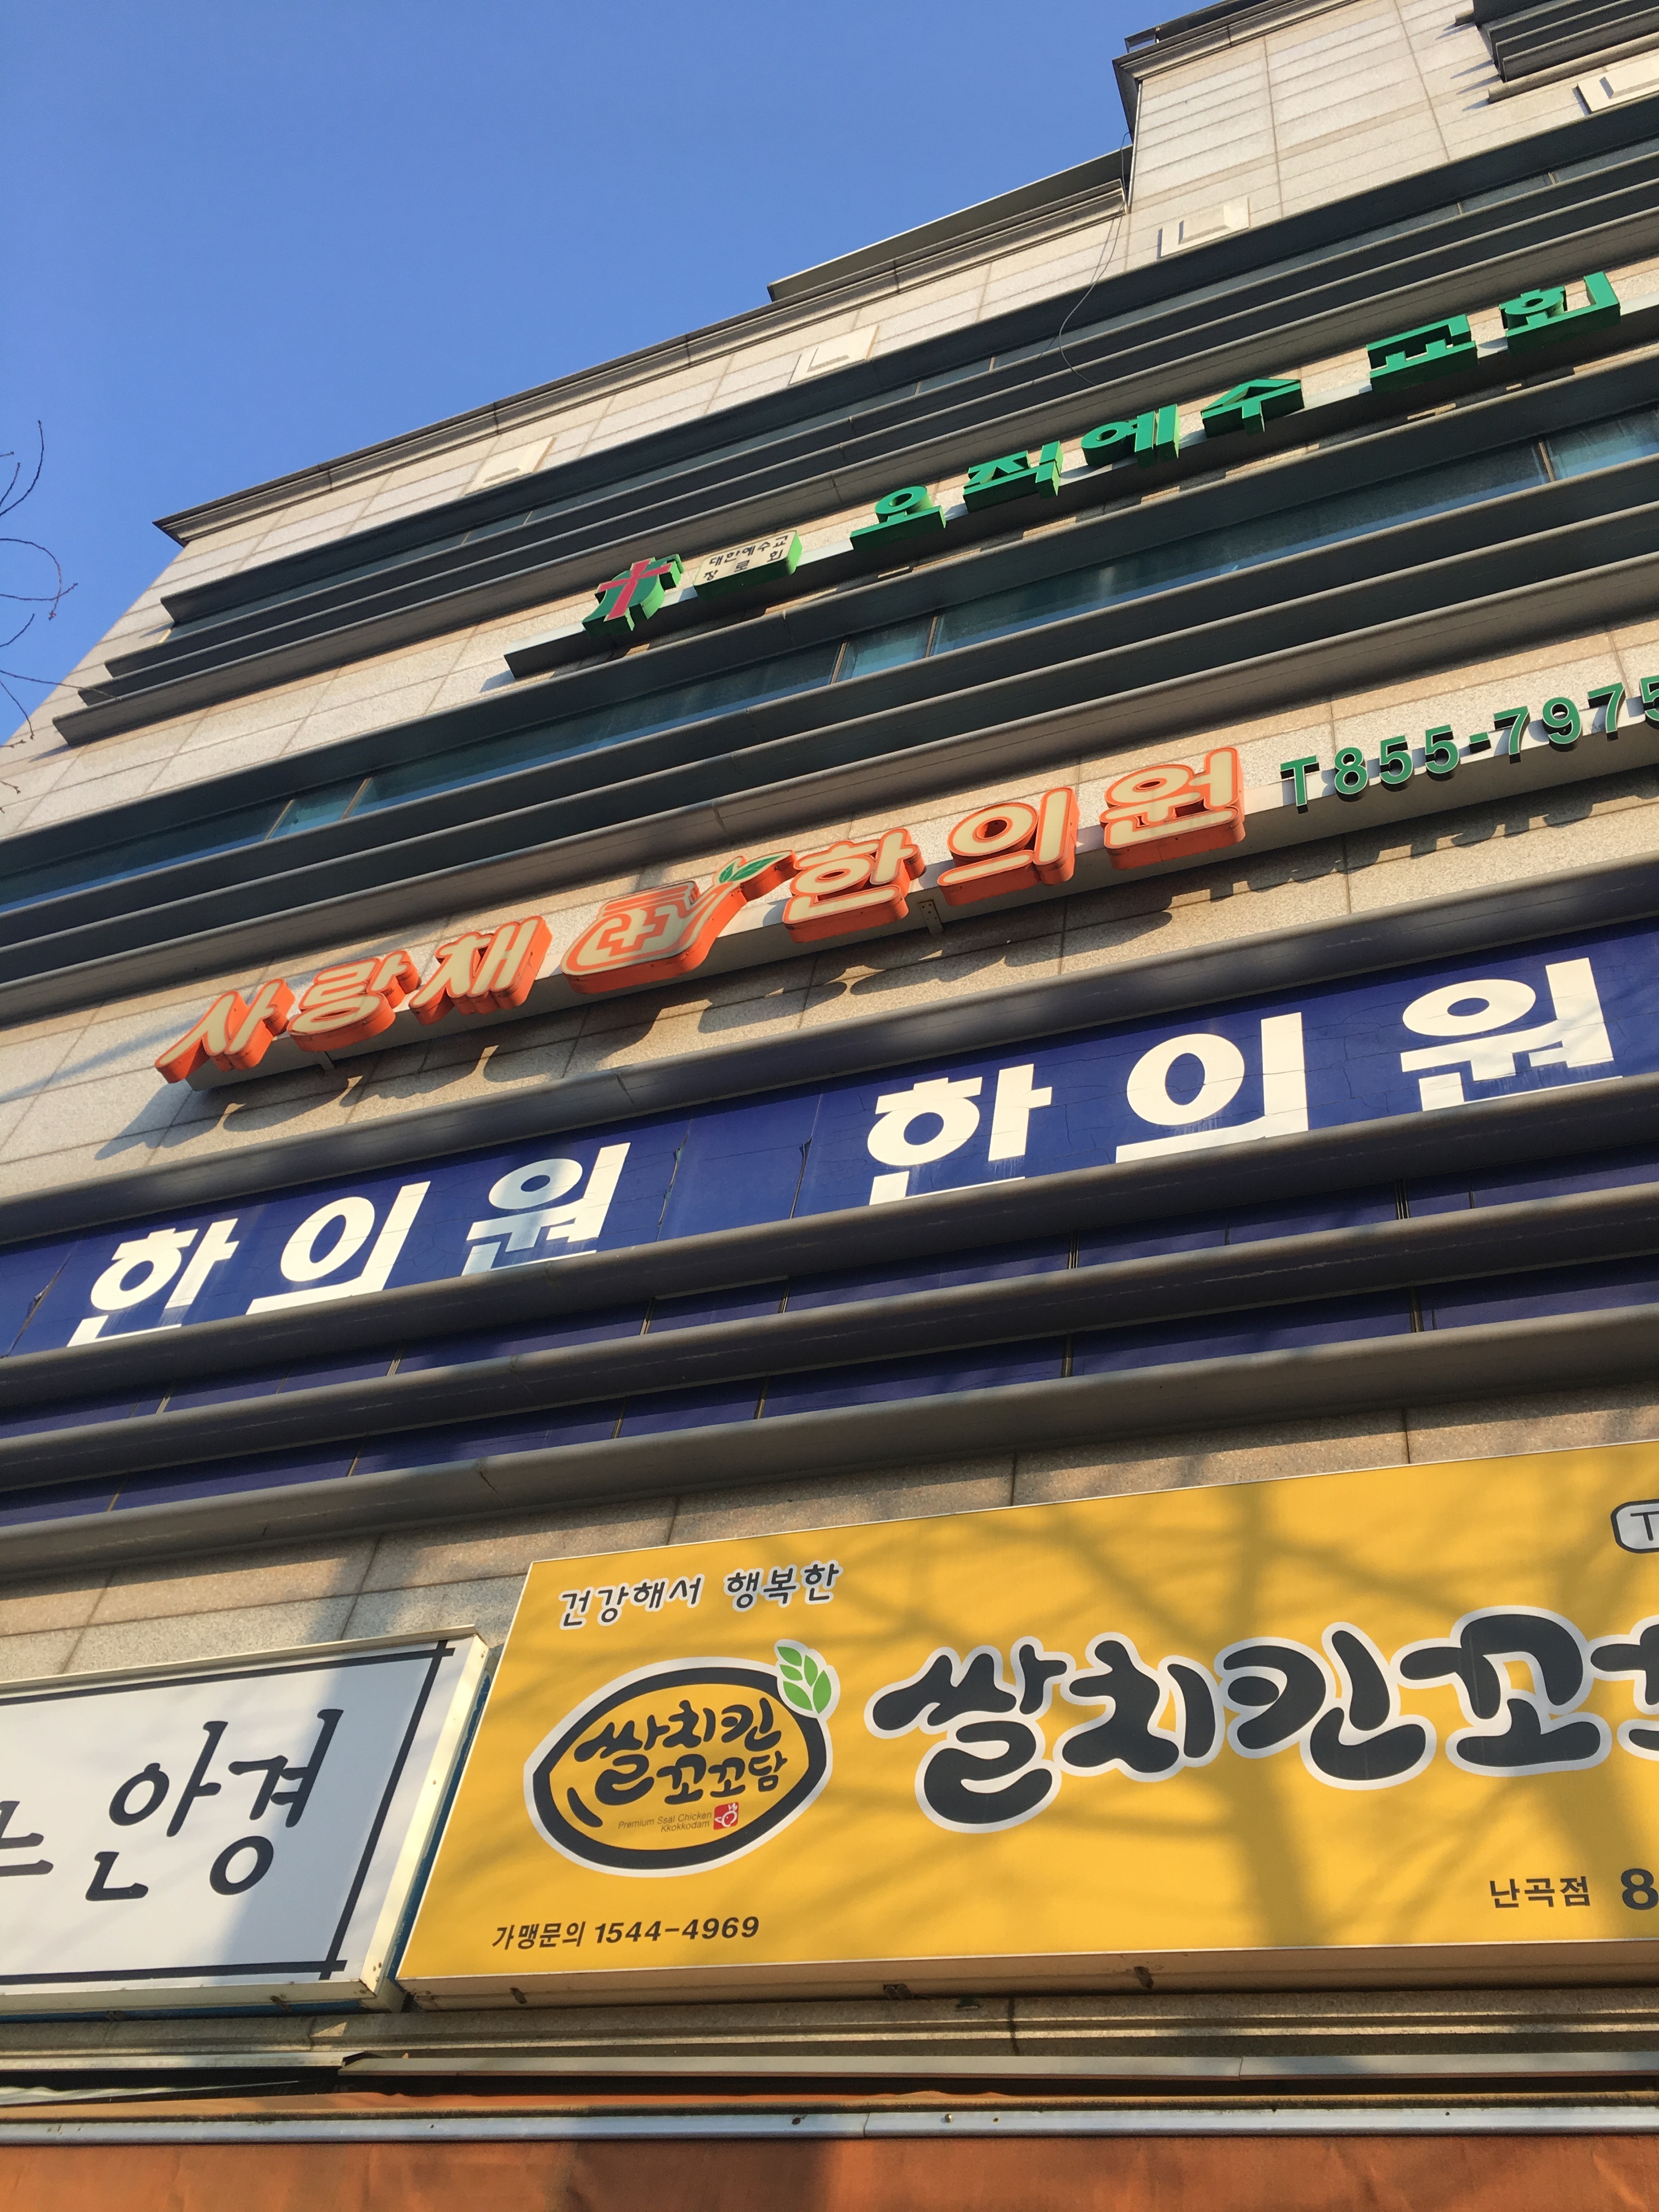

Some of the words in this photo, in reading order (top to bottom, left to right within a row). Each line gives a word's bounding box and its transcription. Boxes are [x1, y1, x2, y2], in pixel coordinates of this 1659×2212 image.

[1367, 271, 1621, 384] 교회
[709, 535, 788, 567] 대한예수교
[155, 916, 552, 1078] 사랑채
[783, 747, 1244, 938] 한의원
[66, 1142, 631, 1347] 한의원
[867, 957, 1624, 1206] 한의원
[561, 1576, 702, 1628] 건강해서
[726, 1562, 840, 1609] 행복한
[656, 1750, 788, 1805] 꼬꼬담
[618, 1818, 654, 1830] Premium
[657, 1815, 675, 1825] Ssal
[678, 1811, 712, 1822] Chicken
[660, 1820, 710, 1833] Kkokkodam
[1489, 1876, 1590, 1909] 난곡점
[492, 1921, 586, 1950] 가맹문의
[594, 1916, 760, 1944] 1544-4969
